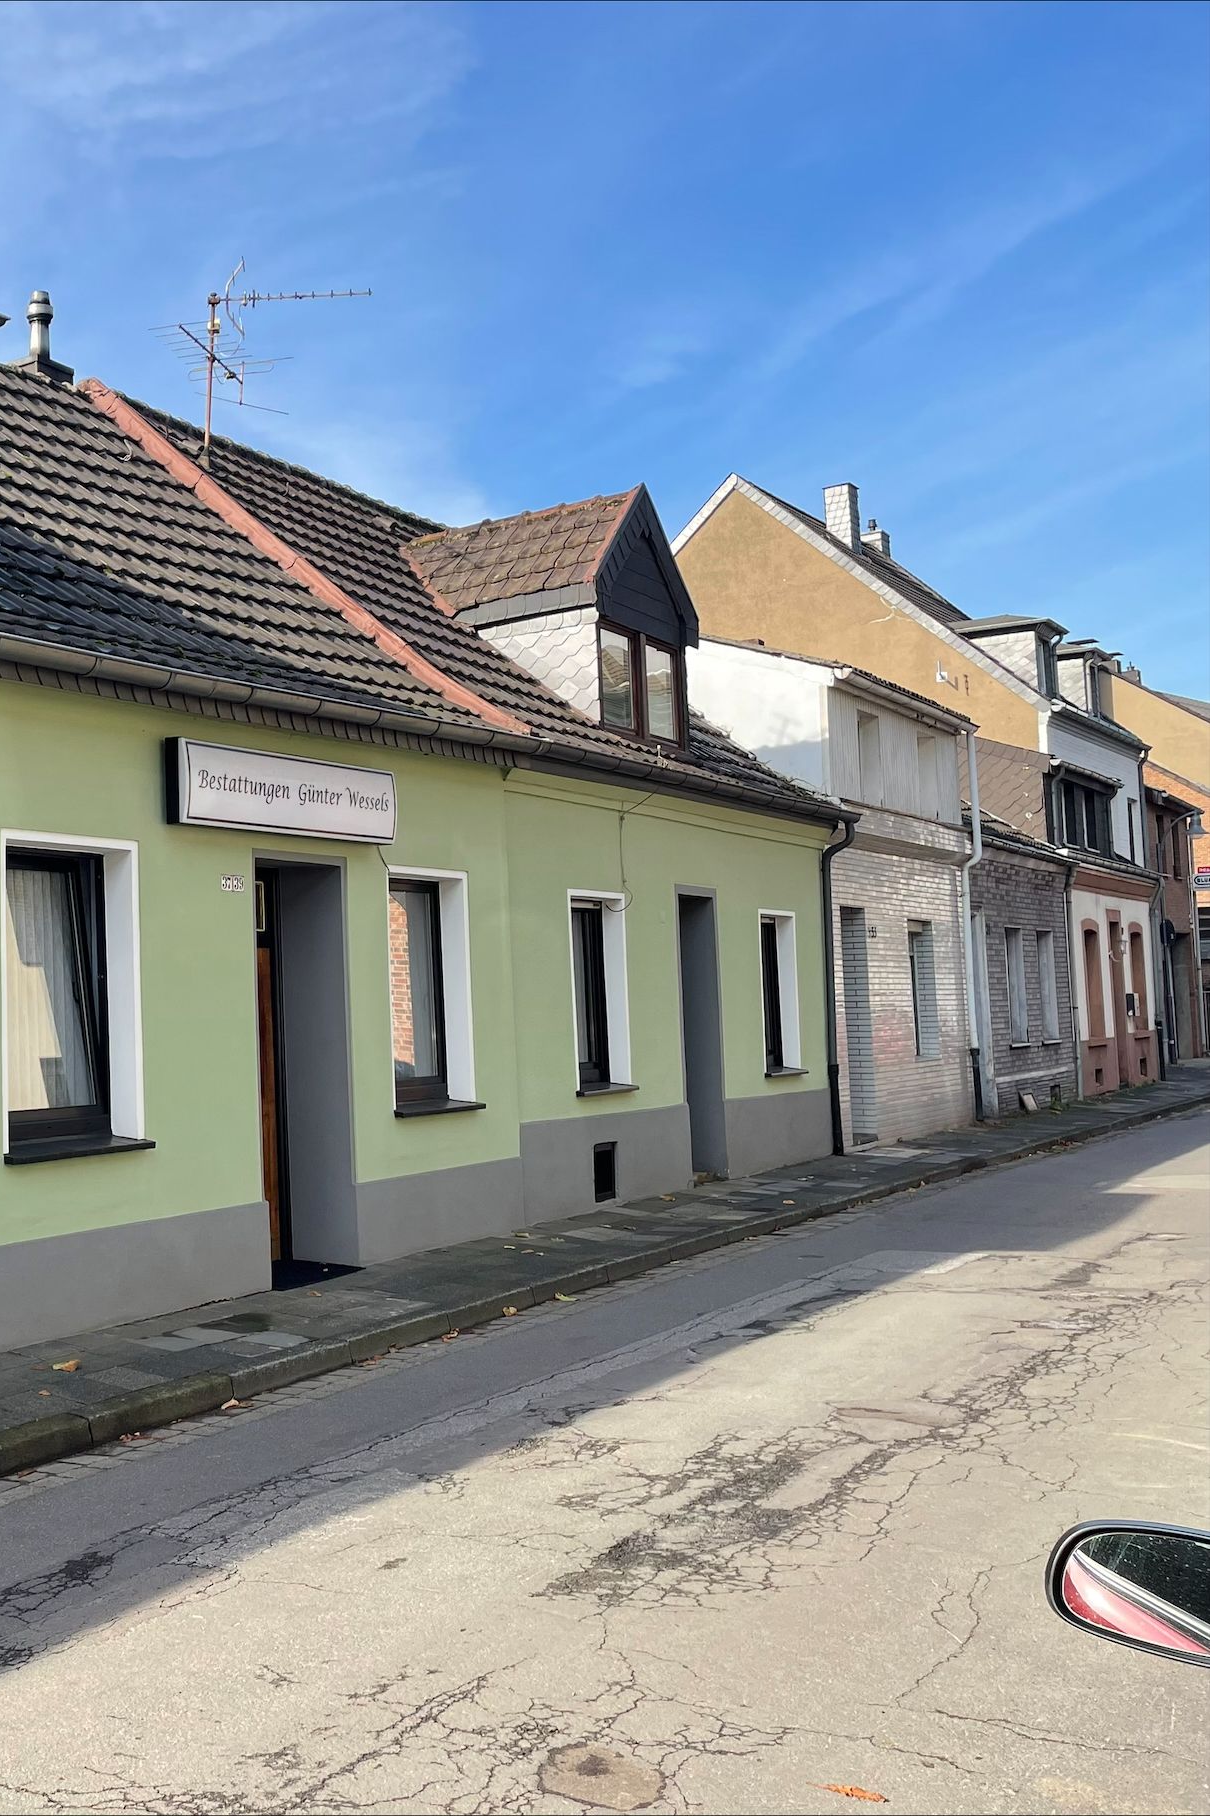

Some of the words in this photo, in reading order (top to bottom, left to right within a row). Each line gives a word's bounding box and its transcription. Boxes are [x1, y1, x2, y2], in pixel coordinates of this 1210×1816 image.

[198, 769, 290, 805] Bestattungen
[298, 783, 343, 806] Günter
[345, 787, 390, 812] Wessels
